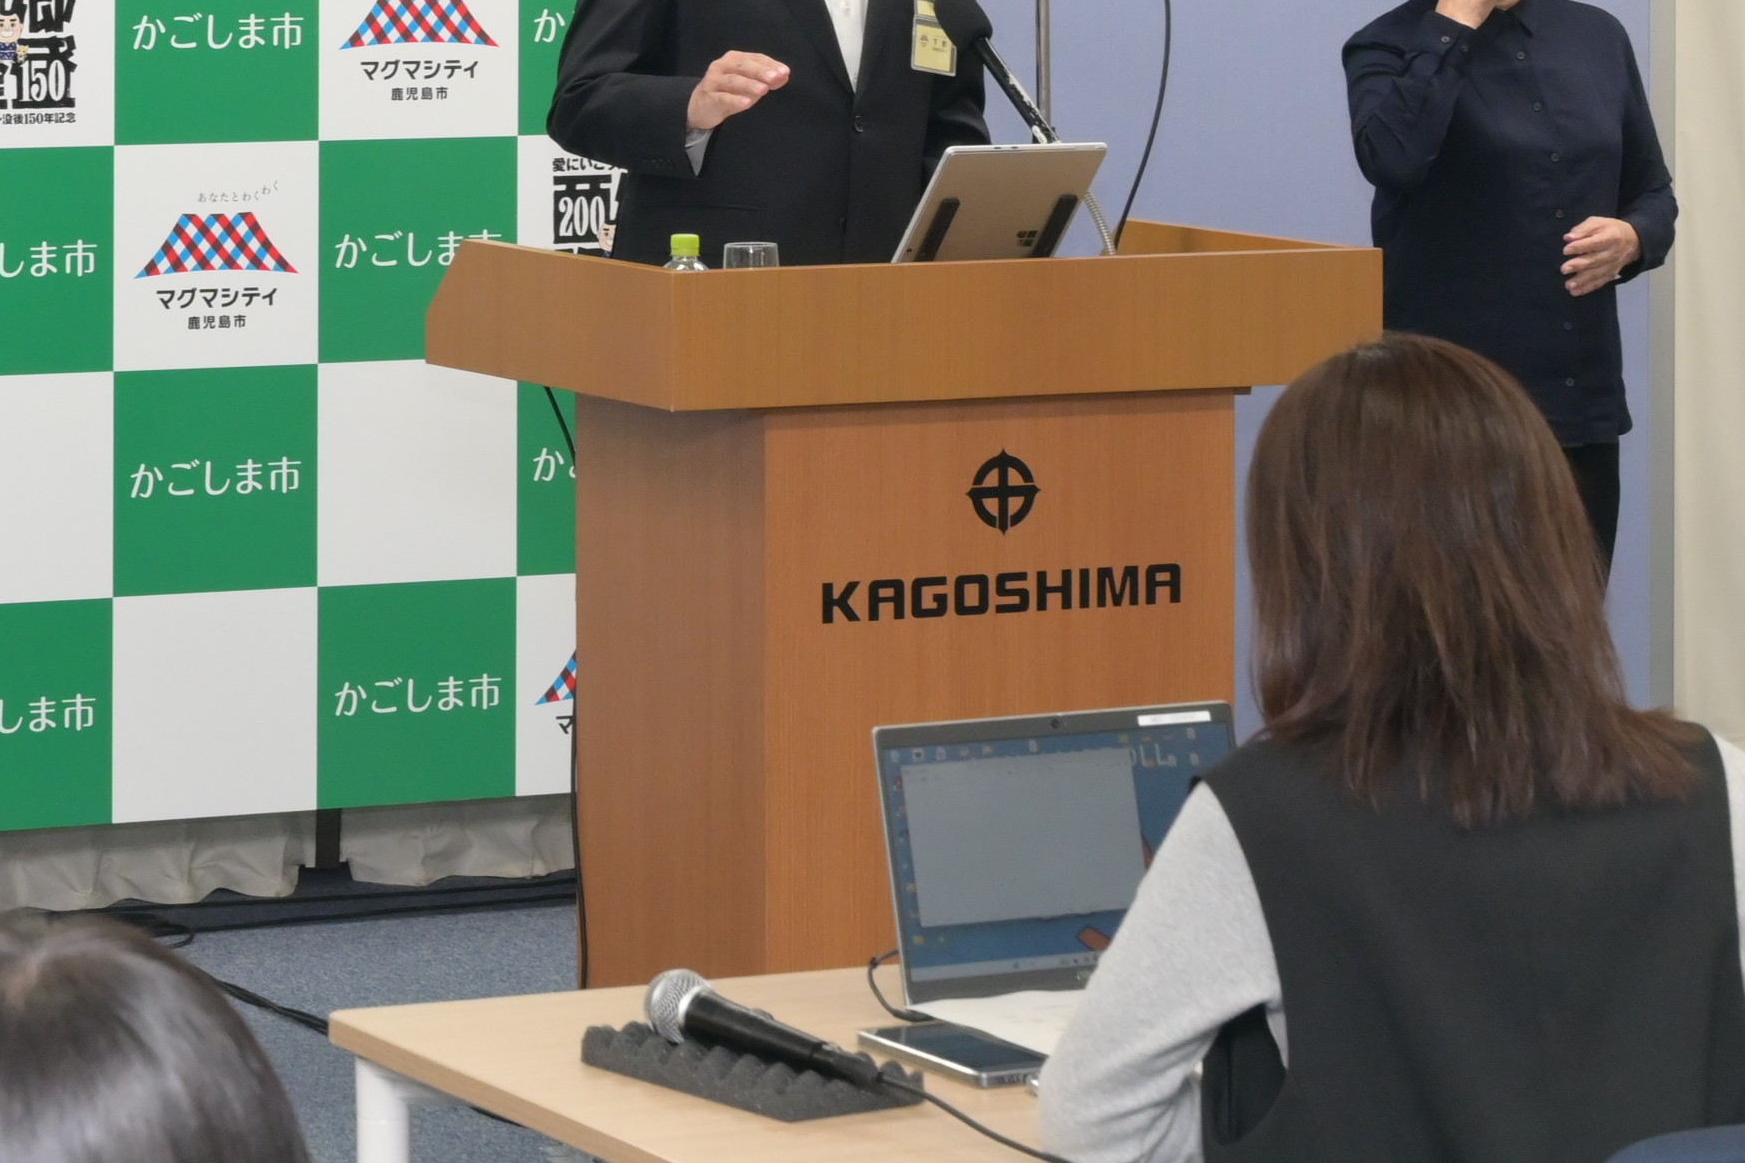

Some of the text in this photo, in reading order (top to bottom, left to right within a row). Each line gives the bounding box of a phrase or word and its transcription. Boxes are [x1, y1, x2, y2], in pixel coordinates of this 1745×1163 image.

[133, 12, 304, 50] かごしま市
[361, 60, 478, 80] マグマシティ
[391, 87, 448, 101] 鹿児島市
[196, 180, 279, 202] あなたとわくわく
[335, 229, 503, 270] かごしま
[157, 287, 277, 309] マグマシティ
[188, 315, 246, 329] 鹿児島市
[131, 456, 302, 498] かごしま市
[822, 563, 1182, 624] KAGOSHIMA
[335, 673, 501, 716] かごしま市
